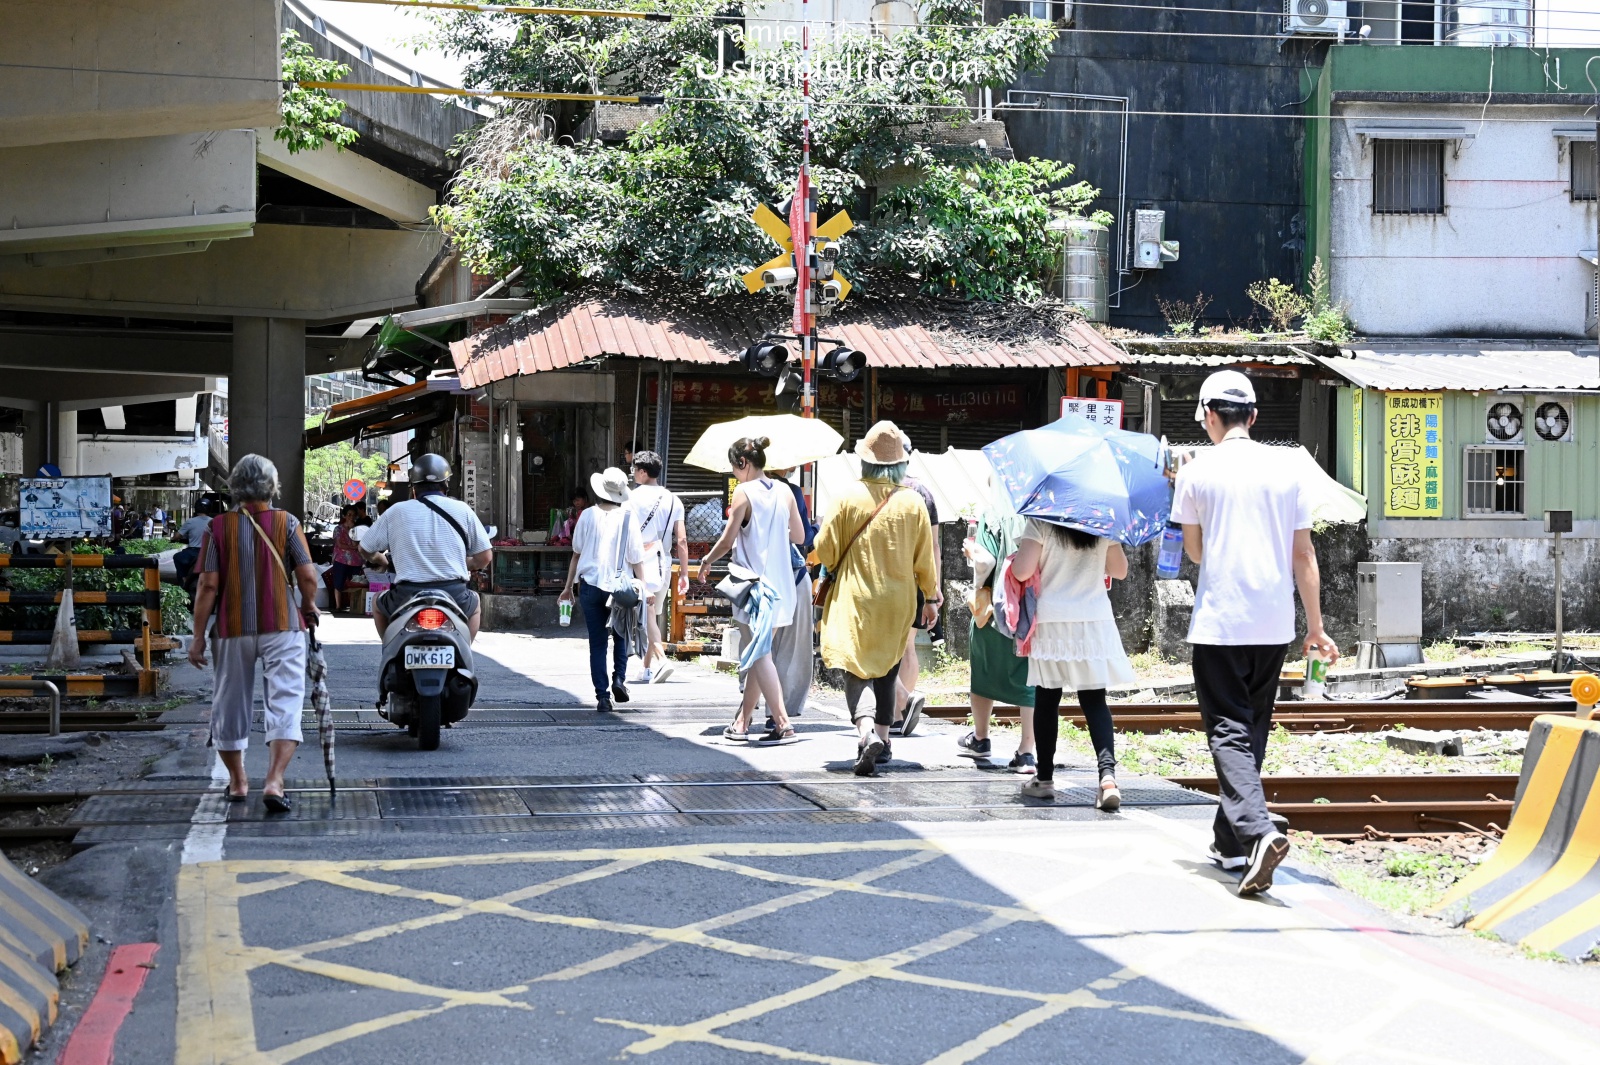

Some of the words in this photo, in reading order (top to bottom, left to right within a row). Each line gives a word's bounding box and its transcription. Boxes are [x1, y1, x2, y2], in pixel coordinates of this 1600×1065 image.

[1388, 397, 1440, 408] (原成功橋下)
[1103, 404, 1115, 425] 平交
[1390, 413, 1421, 511] 排骨酥麵
